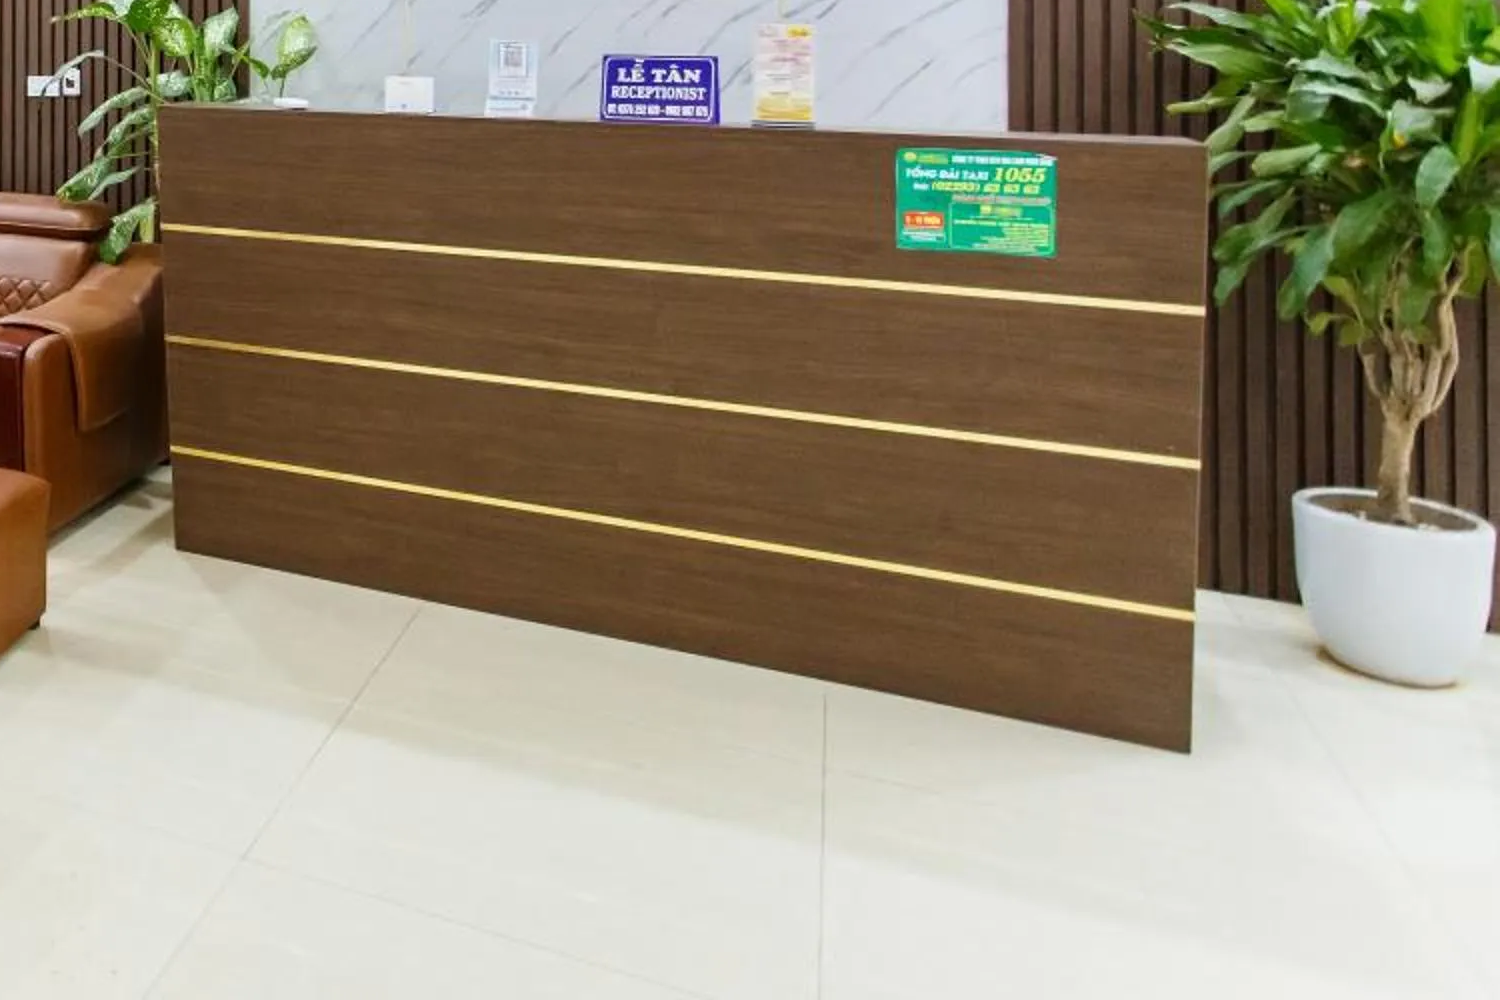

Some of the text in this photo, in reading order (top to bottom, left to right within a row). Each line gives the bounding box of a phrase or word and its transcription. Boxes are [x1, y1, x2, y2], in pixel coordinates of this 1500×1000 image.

[651, 63, 702, 83] TÂN
[611, 85, 706, 101] RECEPTIONIST
[961, 170, 989, 181] TAXI
[994, 167, 1046, 183] 1055
